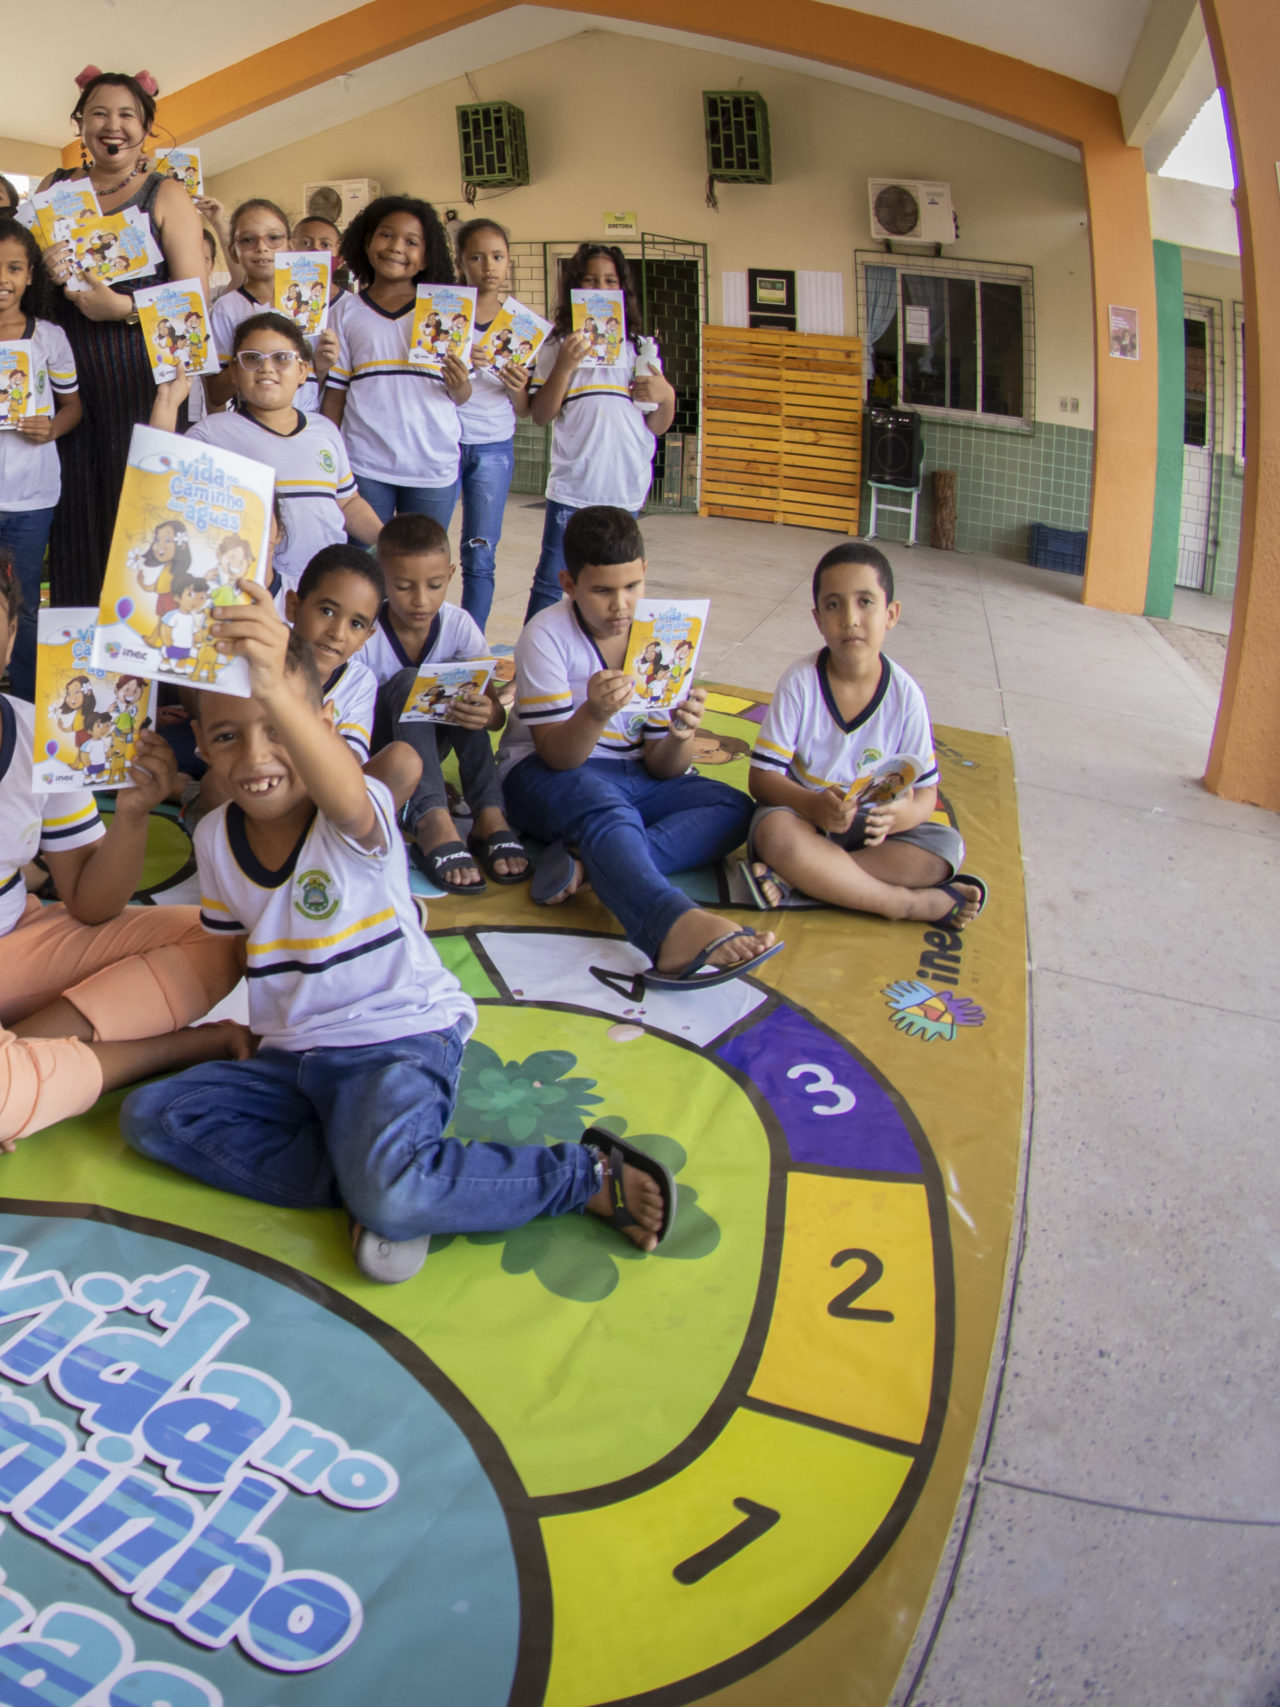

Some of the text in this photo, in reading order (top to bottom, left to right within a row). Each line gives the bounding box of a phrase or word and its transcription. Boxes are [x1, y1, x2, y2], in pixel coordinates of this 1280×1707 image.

[170, 475, 244, 511] Caminho
[184, 500, 240, 531] águas
[122, 648, 148, 660] inec
[916, 931, 963, 986] ine
[787, 1063, 856, 1115] 3
[120, 1264, 210, 1331] A
[827, 1248, 894, 1323] 2
[249, 1417, 399, 1509] no
[672, 1496, 782, 1585] 1
